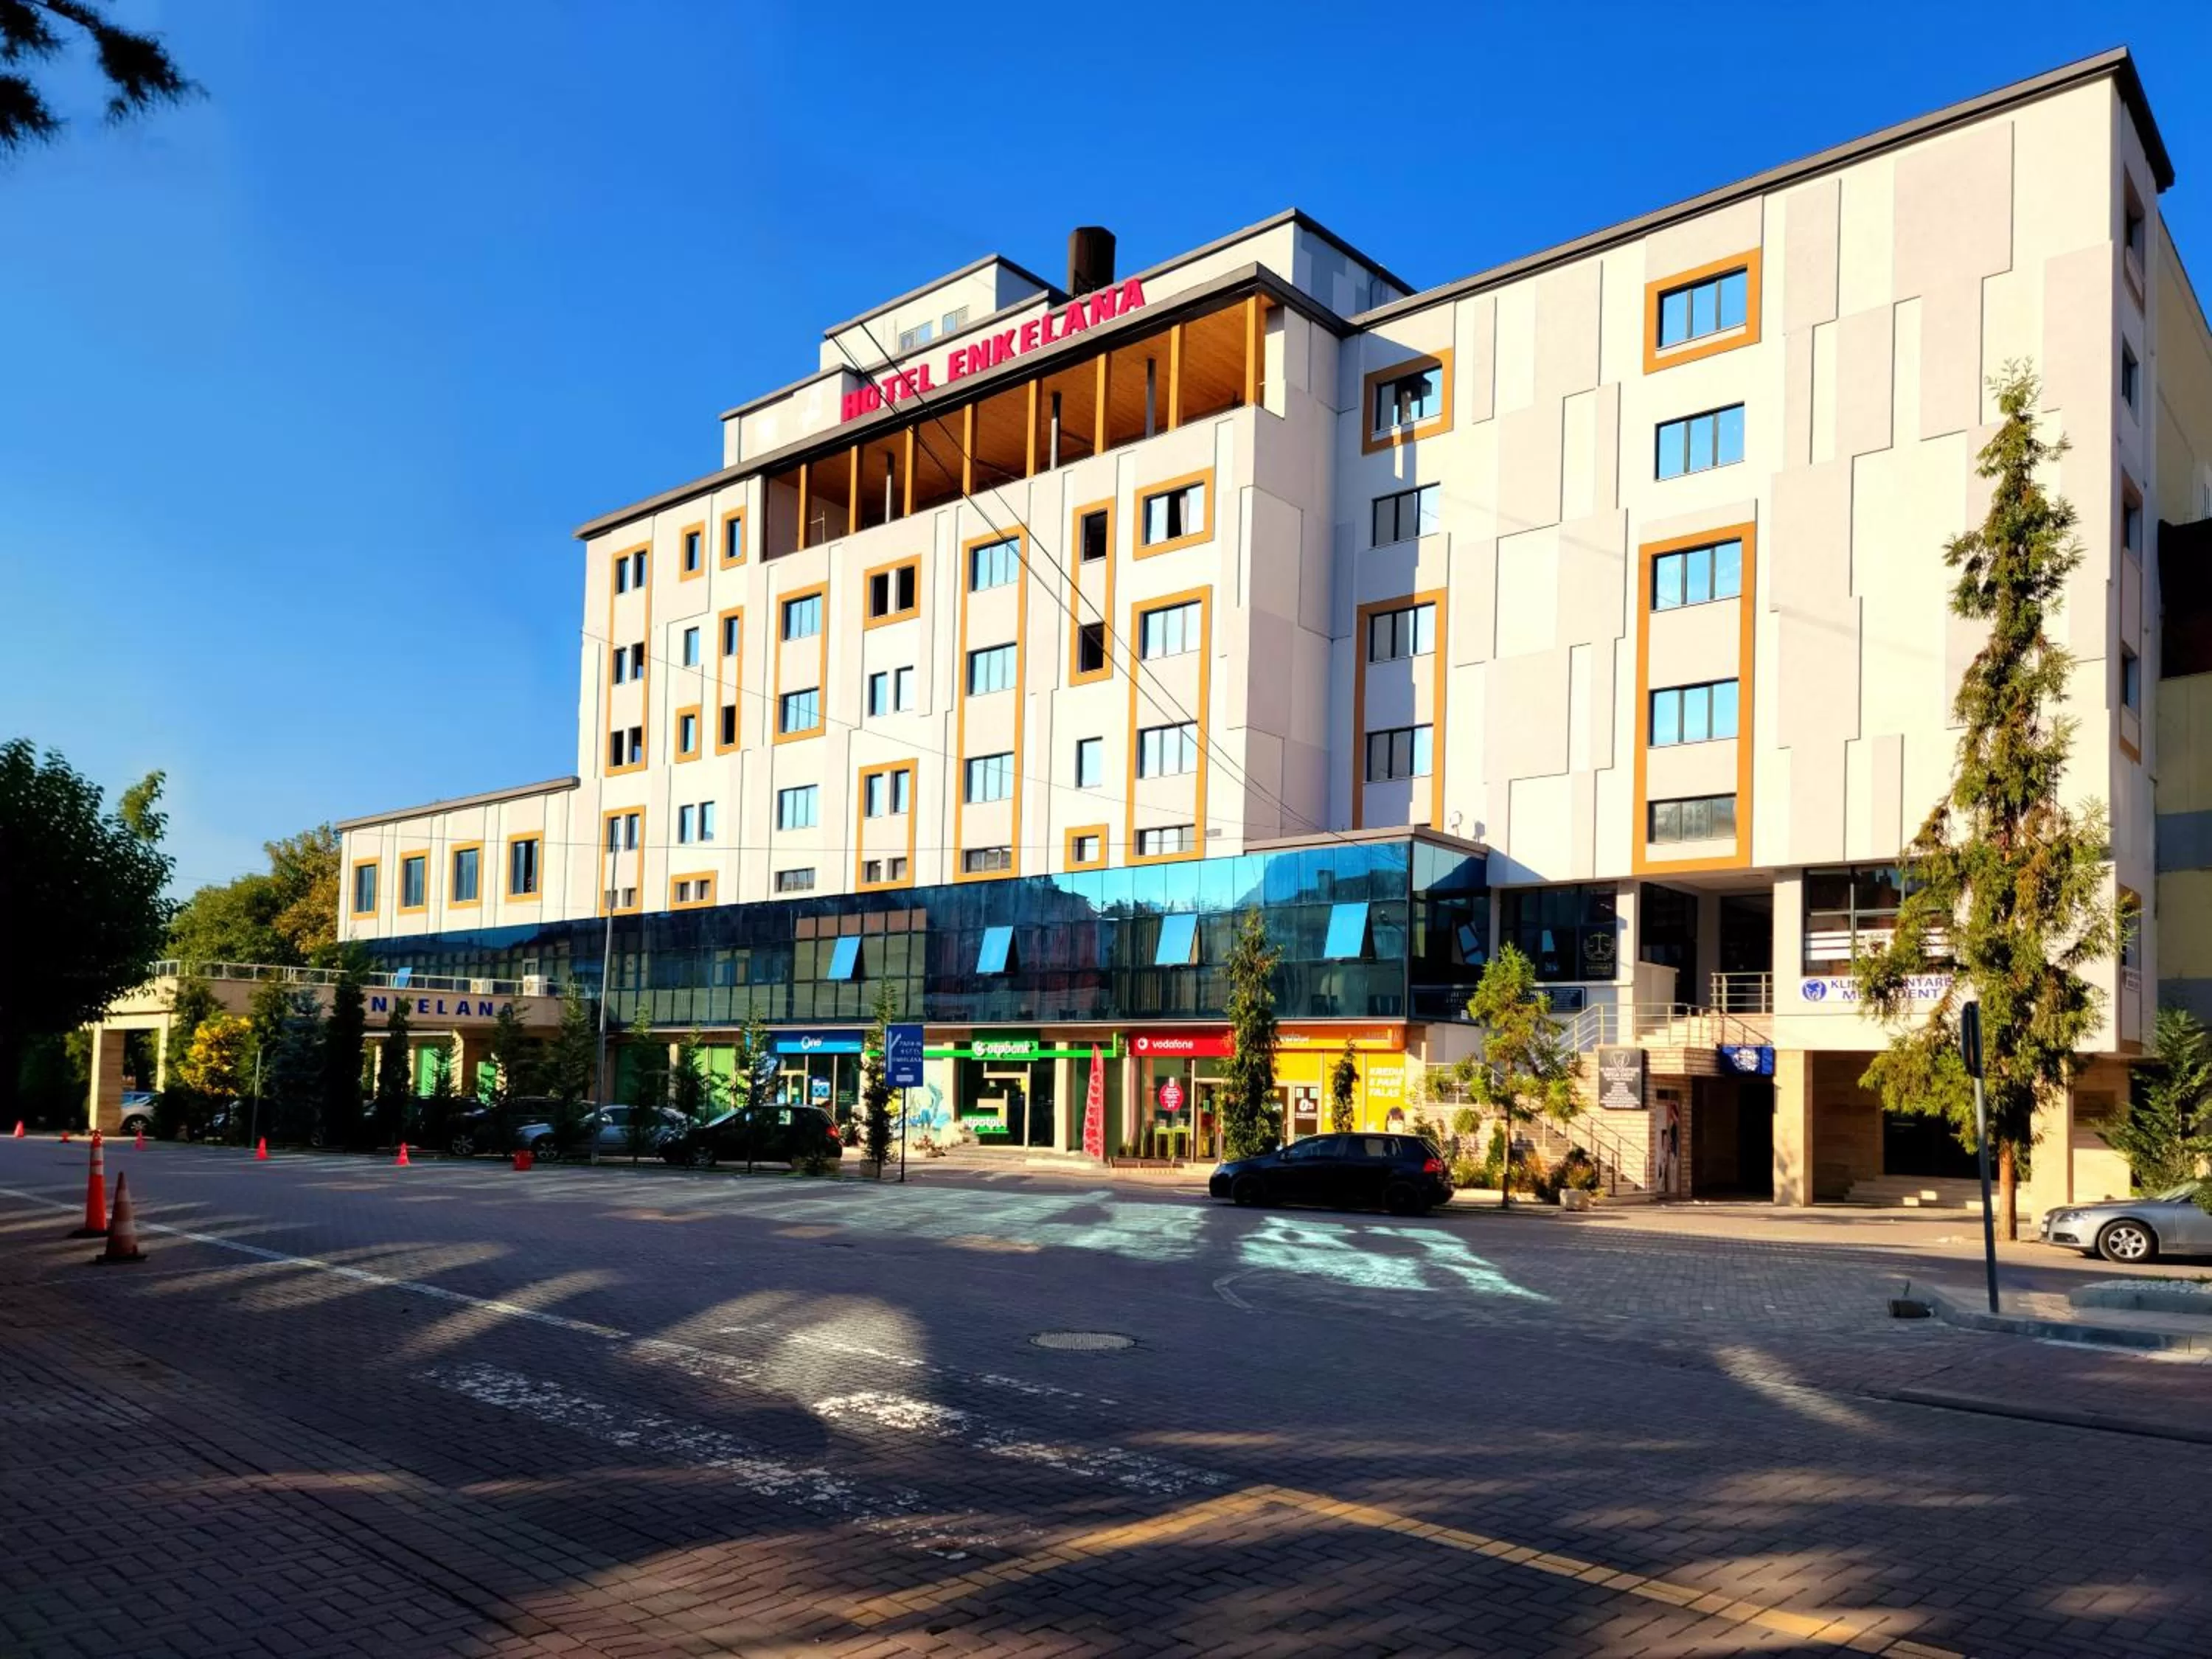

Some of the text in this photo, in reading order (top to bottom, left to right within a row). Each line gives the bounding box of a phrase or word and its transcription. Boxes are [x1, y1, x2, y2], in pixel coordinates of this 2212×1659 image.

[841, 278, 1146, 422] HOTEL ENKELANA
[801, 1036, 822, 1049] One
[987, 1040, 1031, 1057] otpbank
[1152, 1039, 1194, 1050] vodafone
